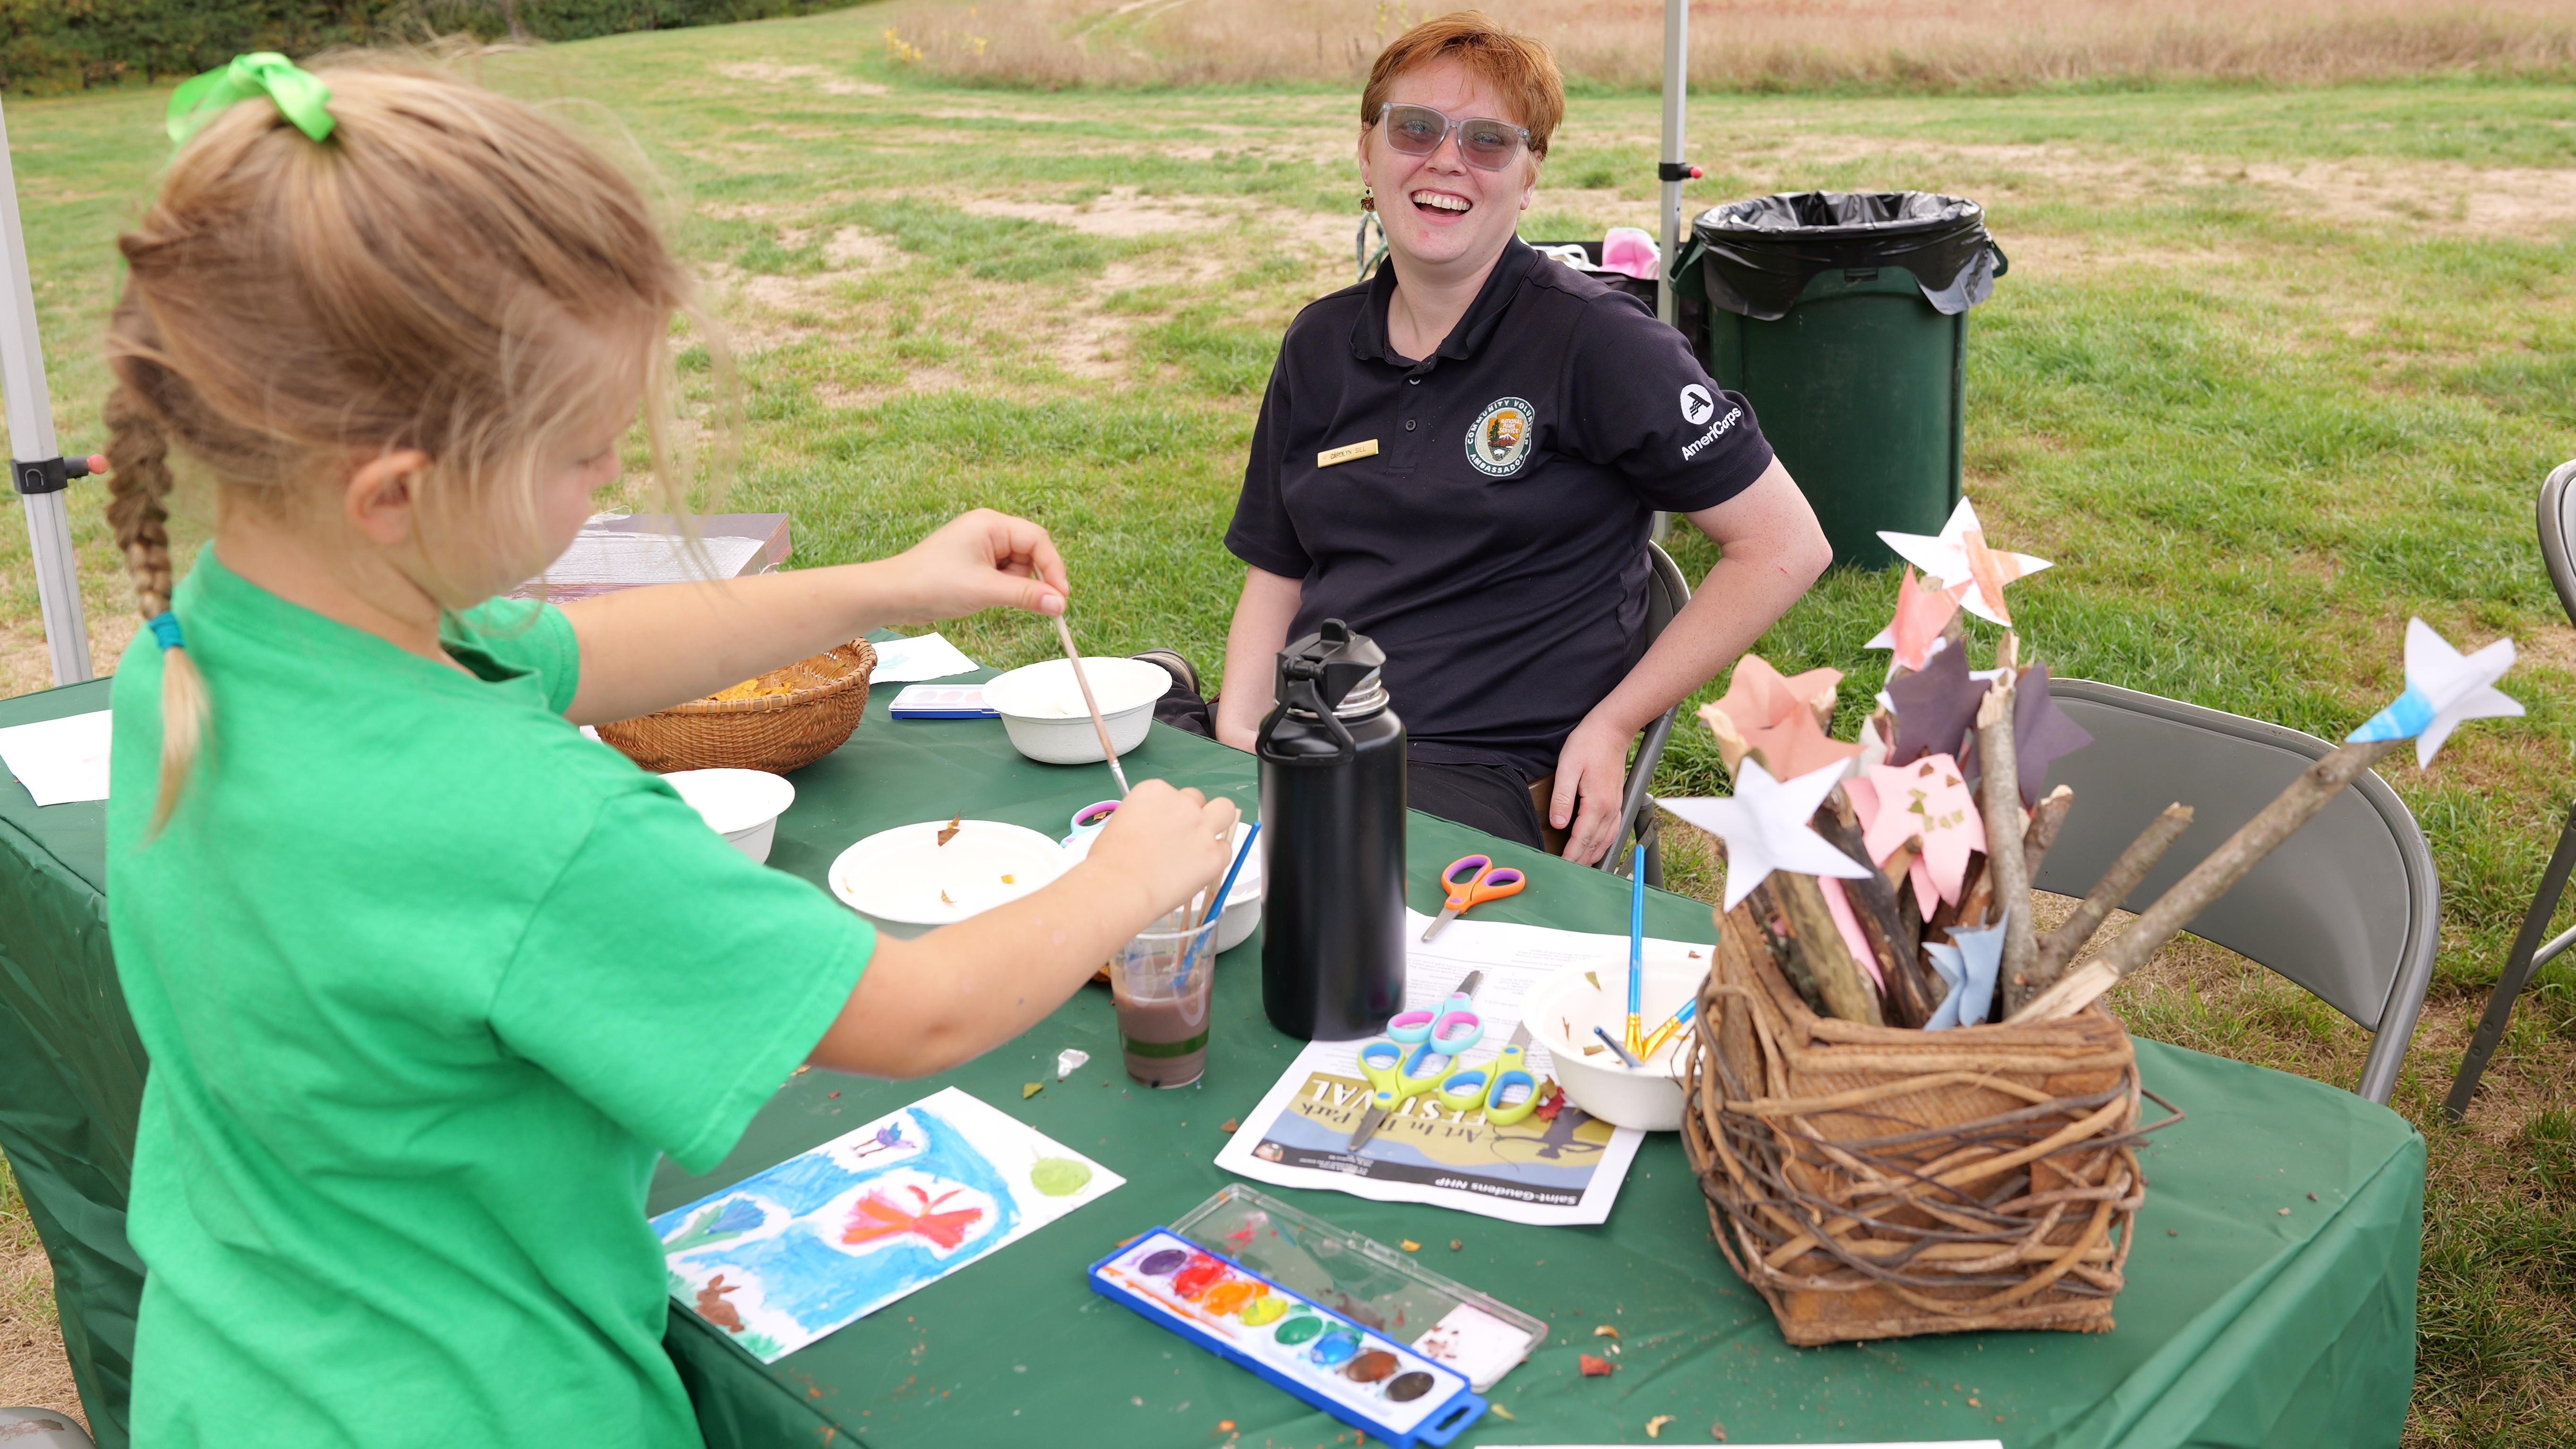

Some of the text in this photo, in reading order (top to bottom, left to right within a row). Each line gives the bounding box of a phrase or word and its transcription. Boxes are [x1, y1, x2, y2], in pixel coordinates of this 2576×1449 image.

[1467, 400, 1509, 444] COMMUNITY
[1331, 450, 1352, 460] CAROLYN
[1470, 453, 1523, 473] AMBASSADOR
[1312, 1079, 1487, 1126] FESTVAL
[1301, 1103, 1351, 1124] Park
[1409, 1121, 1434, 1136] In
[1445, 1127, 1482, 1143] Art
[1434, 1177, 1577, 1205] Saint-Gaudens NHP
